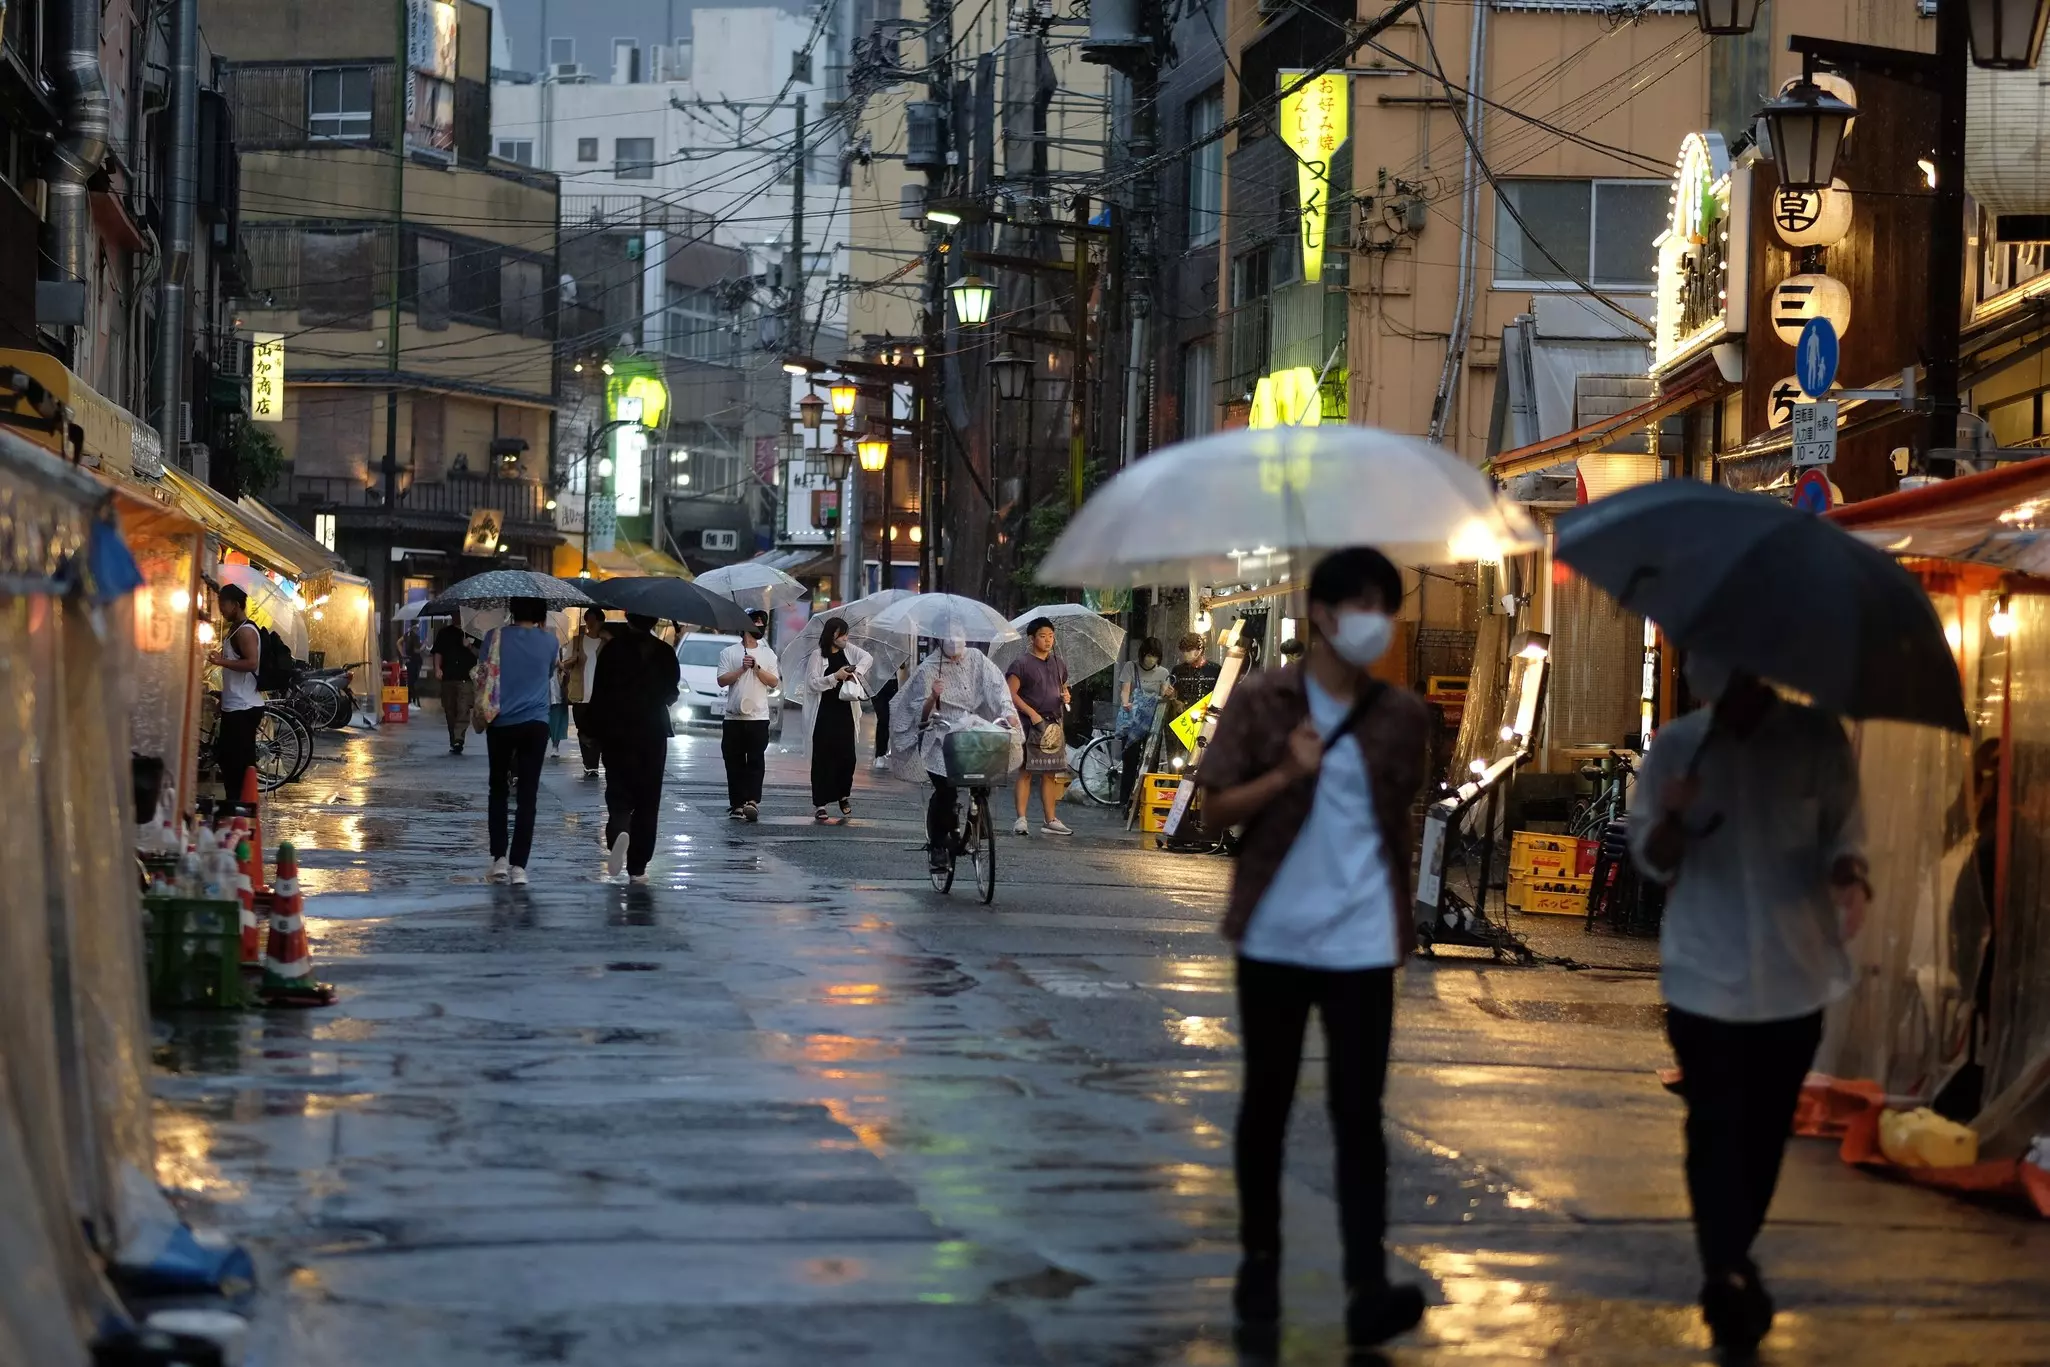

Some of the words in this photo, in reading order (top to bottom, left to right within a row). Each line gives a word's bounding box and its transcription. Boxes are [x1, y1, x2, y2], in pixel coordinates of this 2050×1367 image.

[1318, 78, 1335, 151] お好み焼
[1305, 160, 1326, 248] つくし
[256, 345, 272, 415] 山加商店
